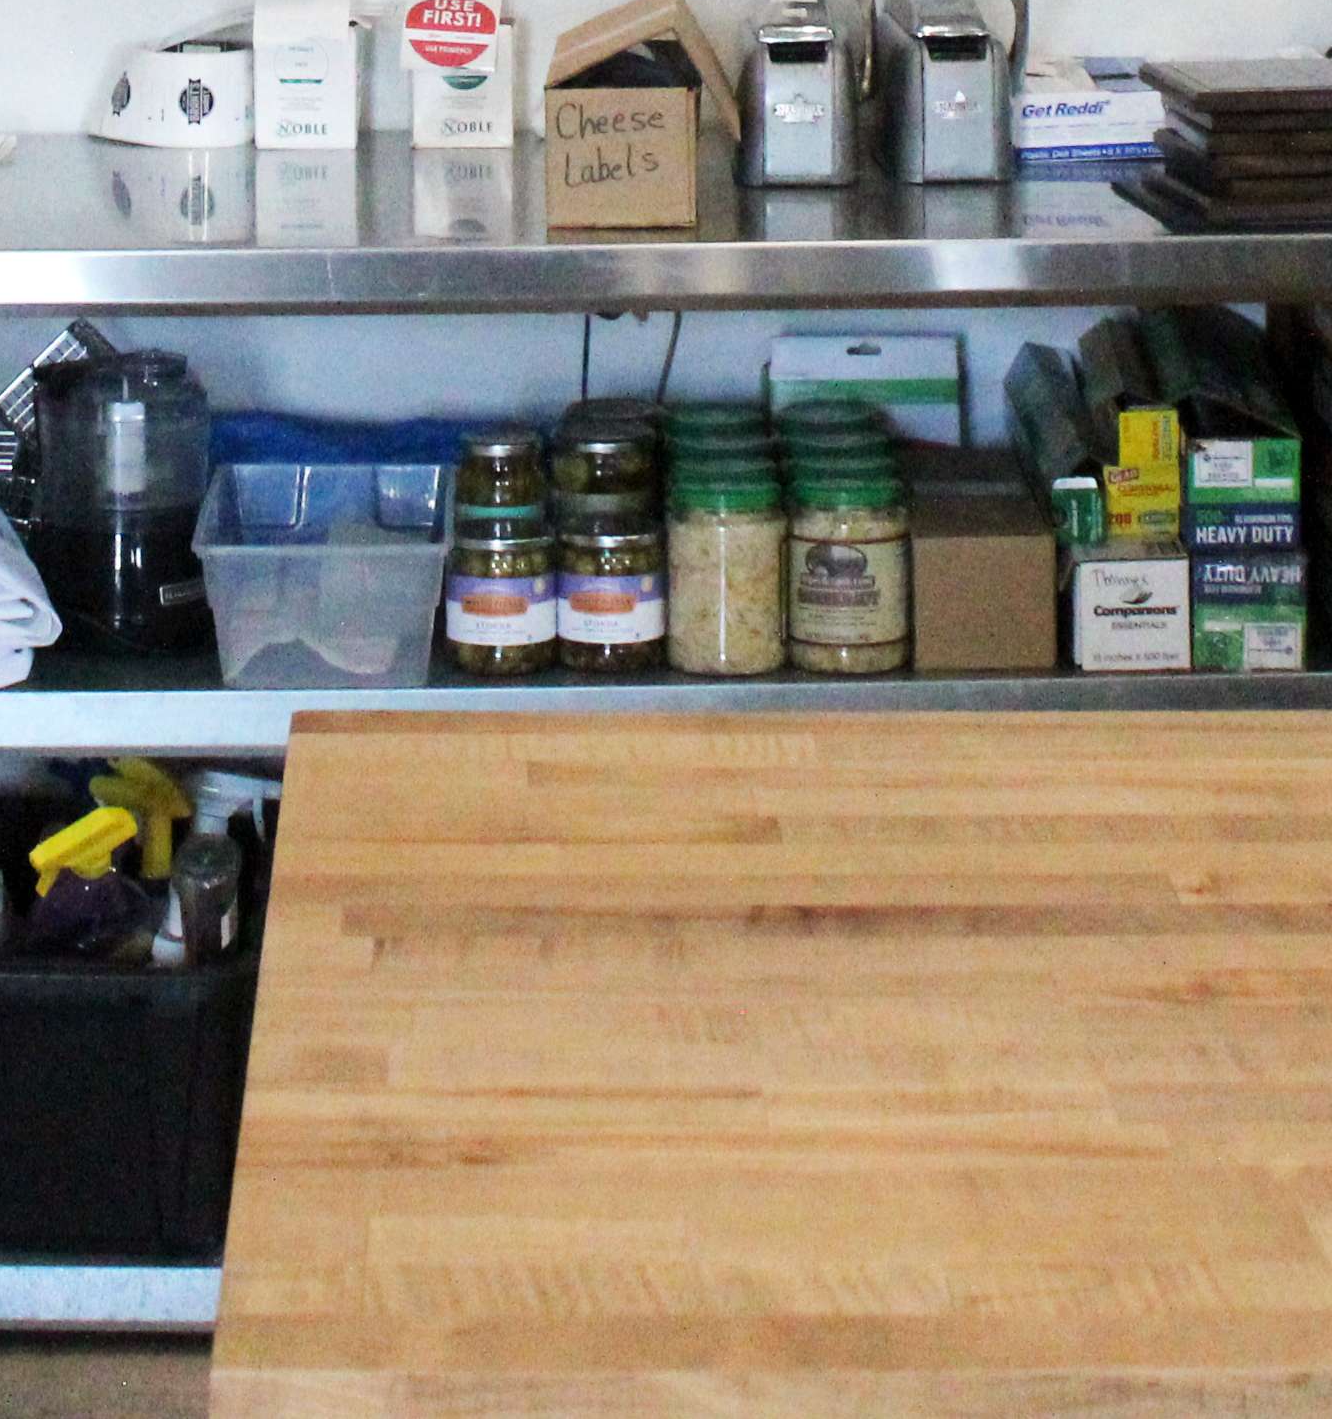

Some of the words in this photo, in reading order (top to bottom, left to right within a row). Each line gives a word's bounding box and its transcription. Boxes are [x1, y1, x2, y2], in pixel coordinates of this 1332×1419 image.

[422, 11, 482, 28] FIRST!
[1022, 104, 1052, 118] Get
[278, 122, 329, 137] NOBLE
[442, 120, 493, 136] NOBLE
[556, 102, 666, 140] Cheese
[564, 143, 660, 188] Labels
[1195, 526, 1246, 543] HEAVY
[1252, 526, 1294, 543] DUTY
[1204, 564, 1246, 582] DUTY
[1250, 564, 1302, 584] HEAVY
[1094, 605, 1178, 619] Companions
